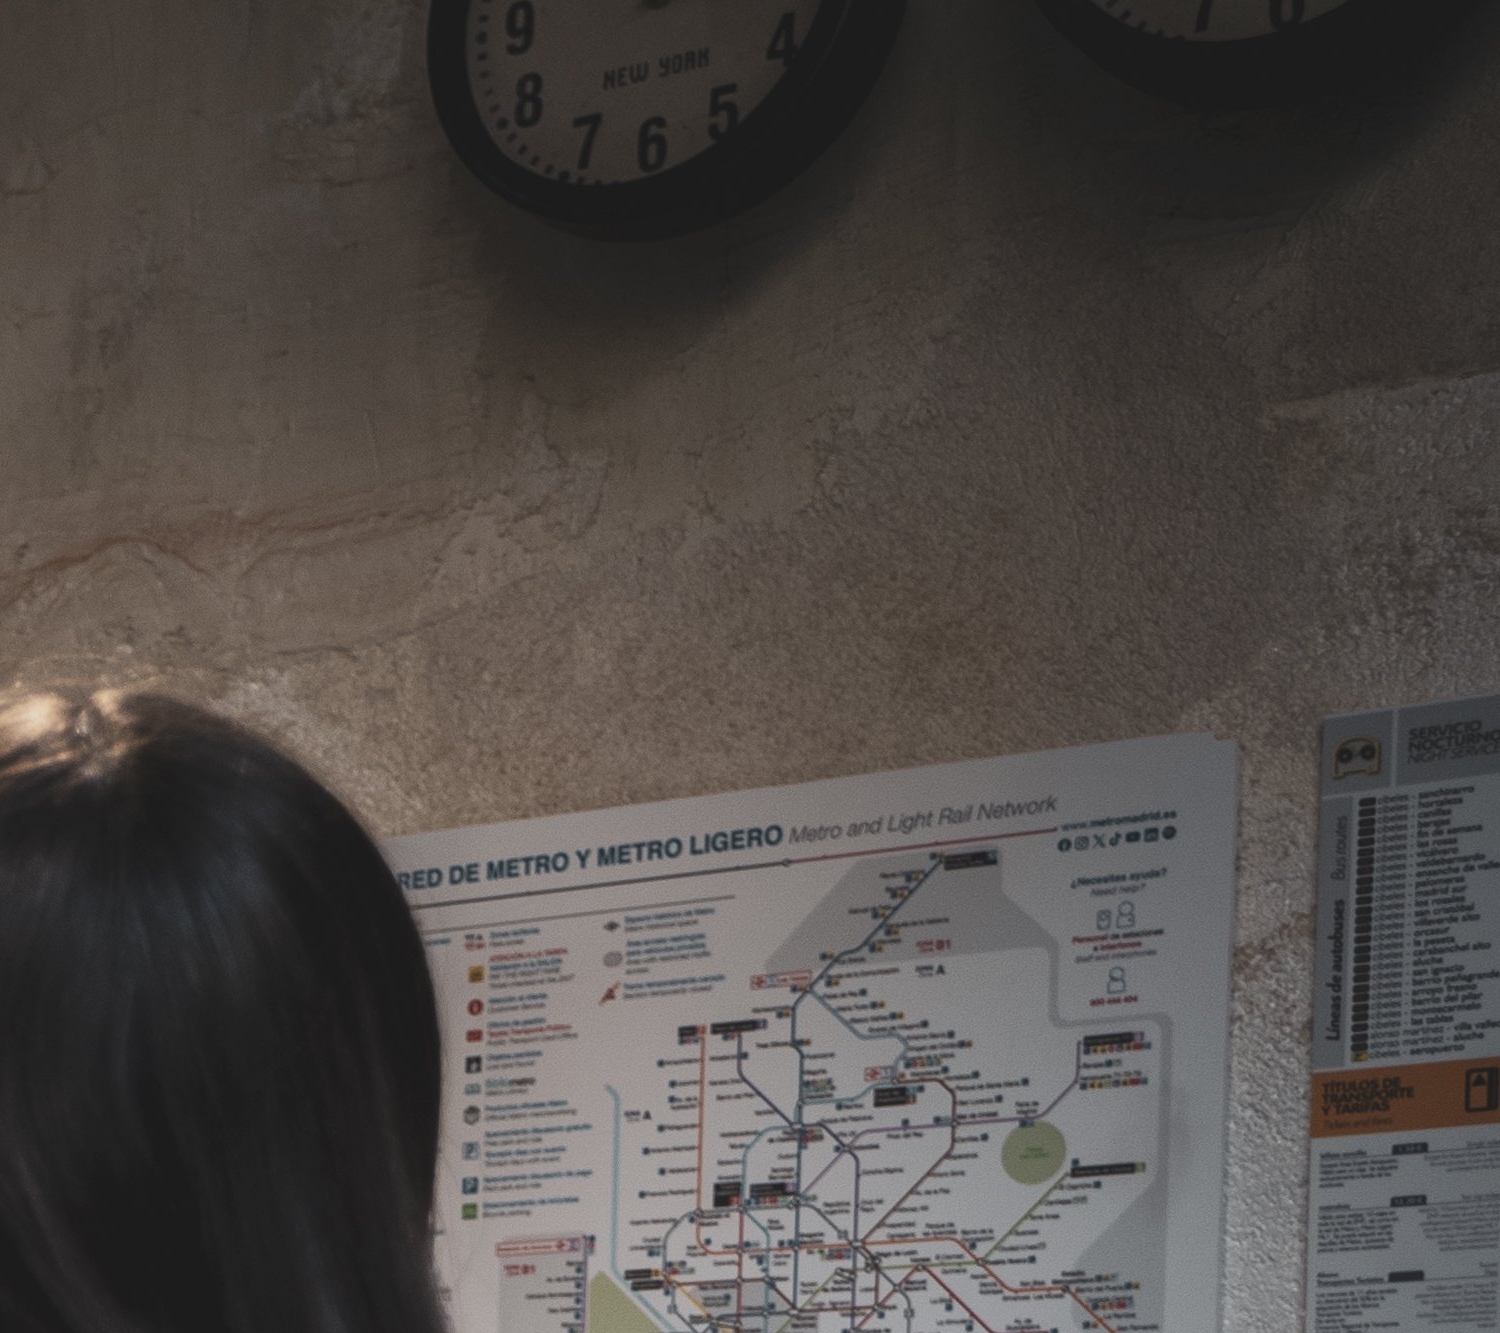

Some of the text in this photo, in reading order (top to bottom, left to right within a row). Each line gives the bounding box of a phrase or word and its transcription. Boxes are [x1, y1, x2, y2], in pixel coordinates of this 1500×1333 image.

[505, 0, 535, 55] 9
[766, 12, 798, 67] 4
[602, 48, 710, 91] NEW YORK
[514, 72, 543, 128] 8
[708, 83, 738, 143] 5
[572, 112, 602, 170] 7
[637, 116, 668, 173] 6
[1408, 720, 1483, 741] SERVICIO
[396, 795, 1058, 890] RED DE METRO Y METRO LIGERO Metro and Light Rail Network
[1330, 857, 1346, 880] Bus
[936, 965, 945, 974] A
[1325, 899, 1344, 1041] Líneas de autobuses
[642, 1110, 652, 1121] A
